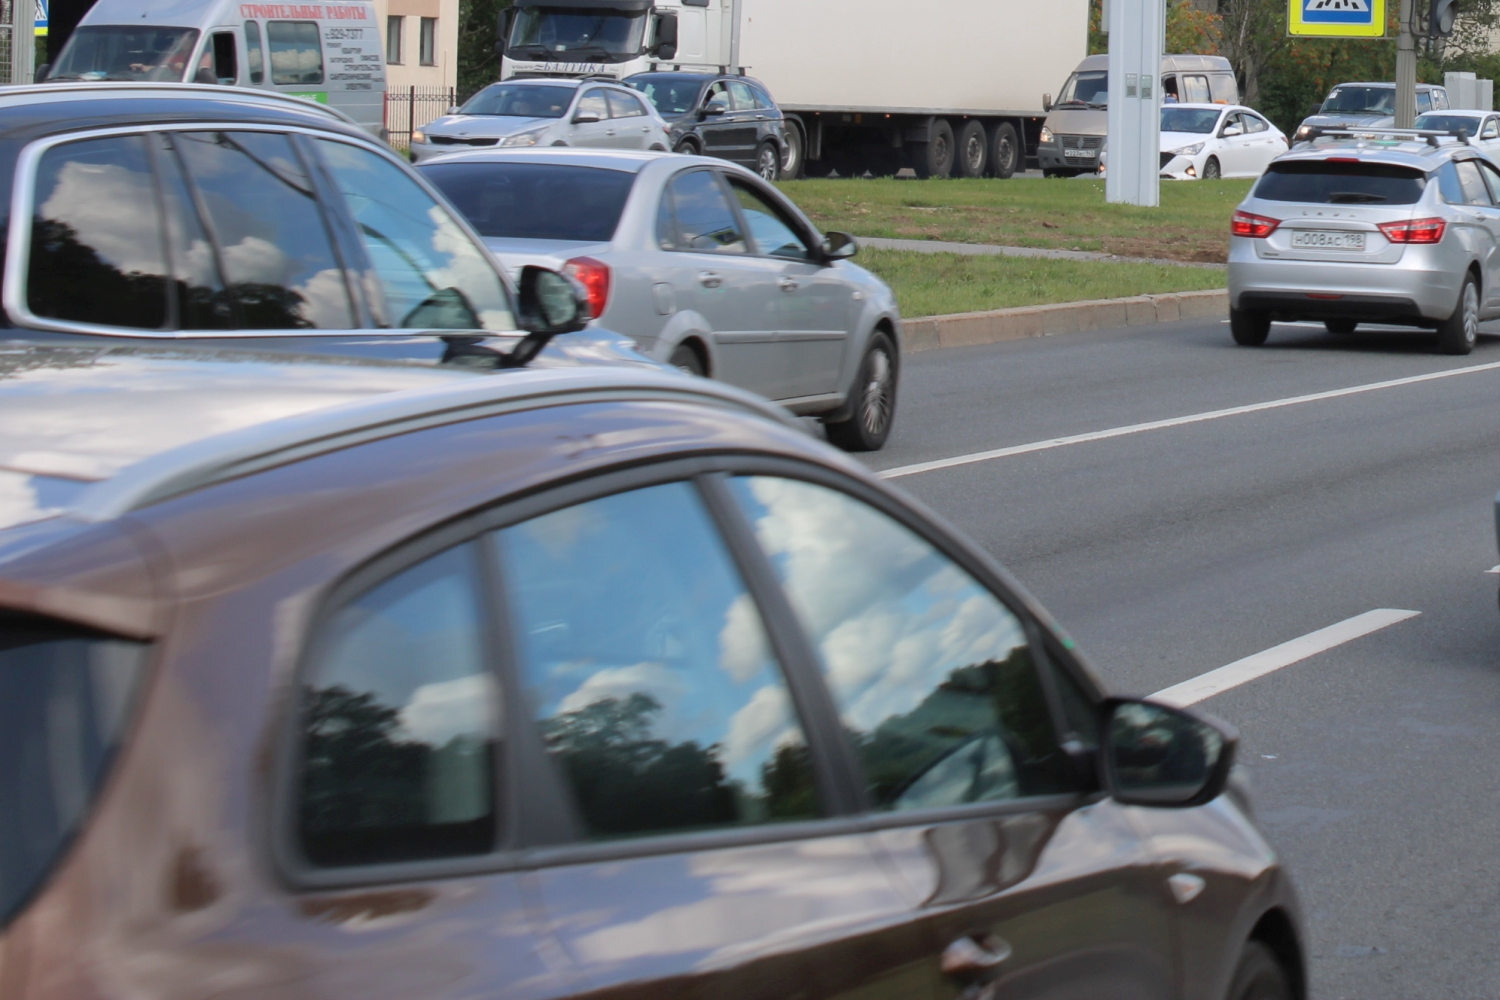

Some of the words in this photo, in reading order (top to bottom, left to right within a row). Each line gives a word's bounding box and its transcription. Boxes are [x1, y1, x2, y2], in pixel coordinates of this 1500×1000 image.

[240, 4, 324, 19] СТРОИТЕЛЬНЫЕ
[326, 5, 367, 20] РАБОТЫ
[534, 62, 606, 73] БАЛТИКА
